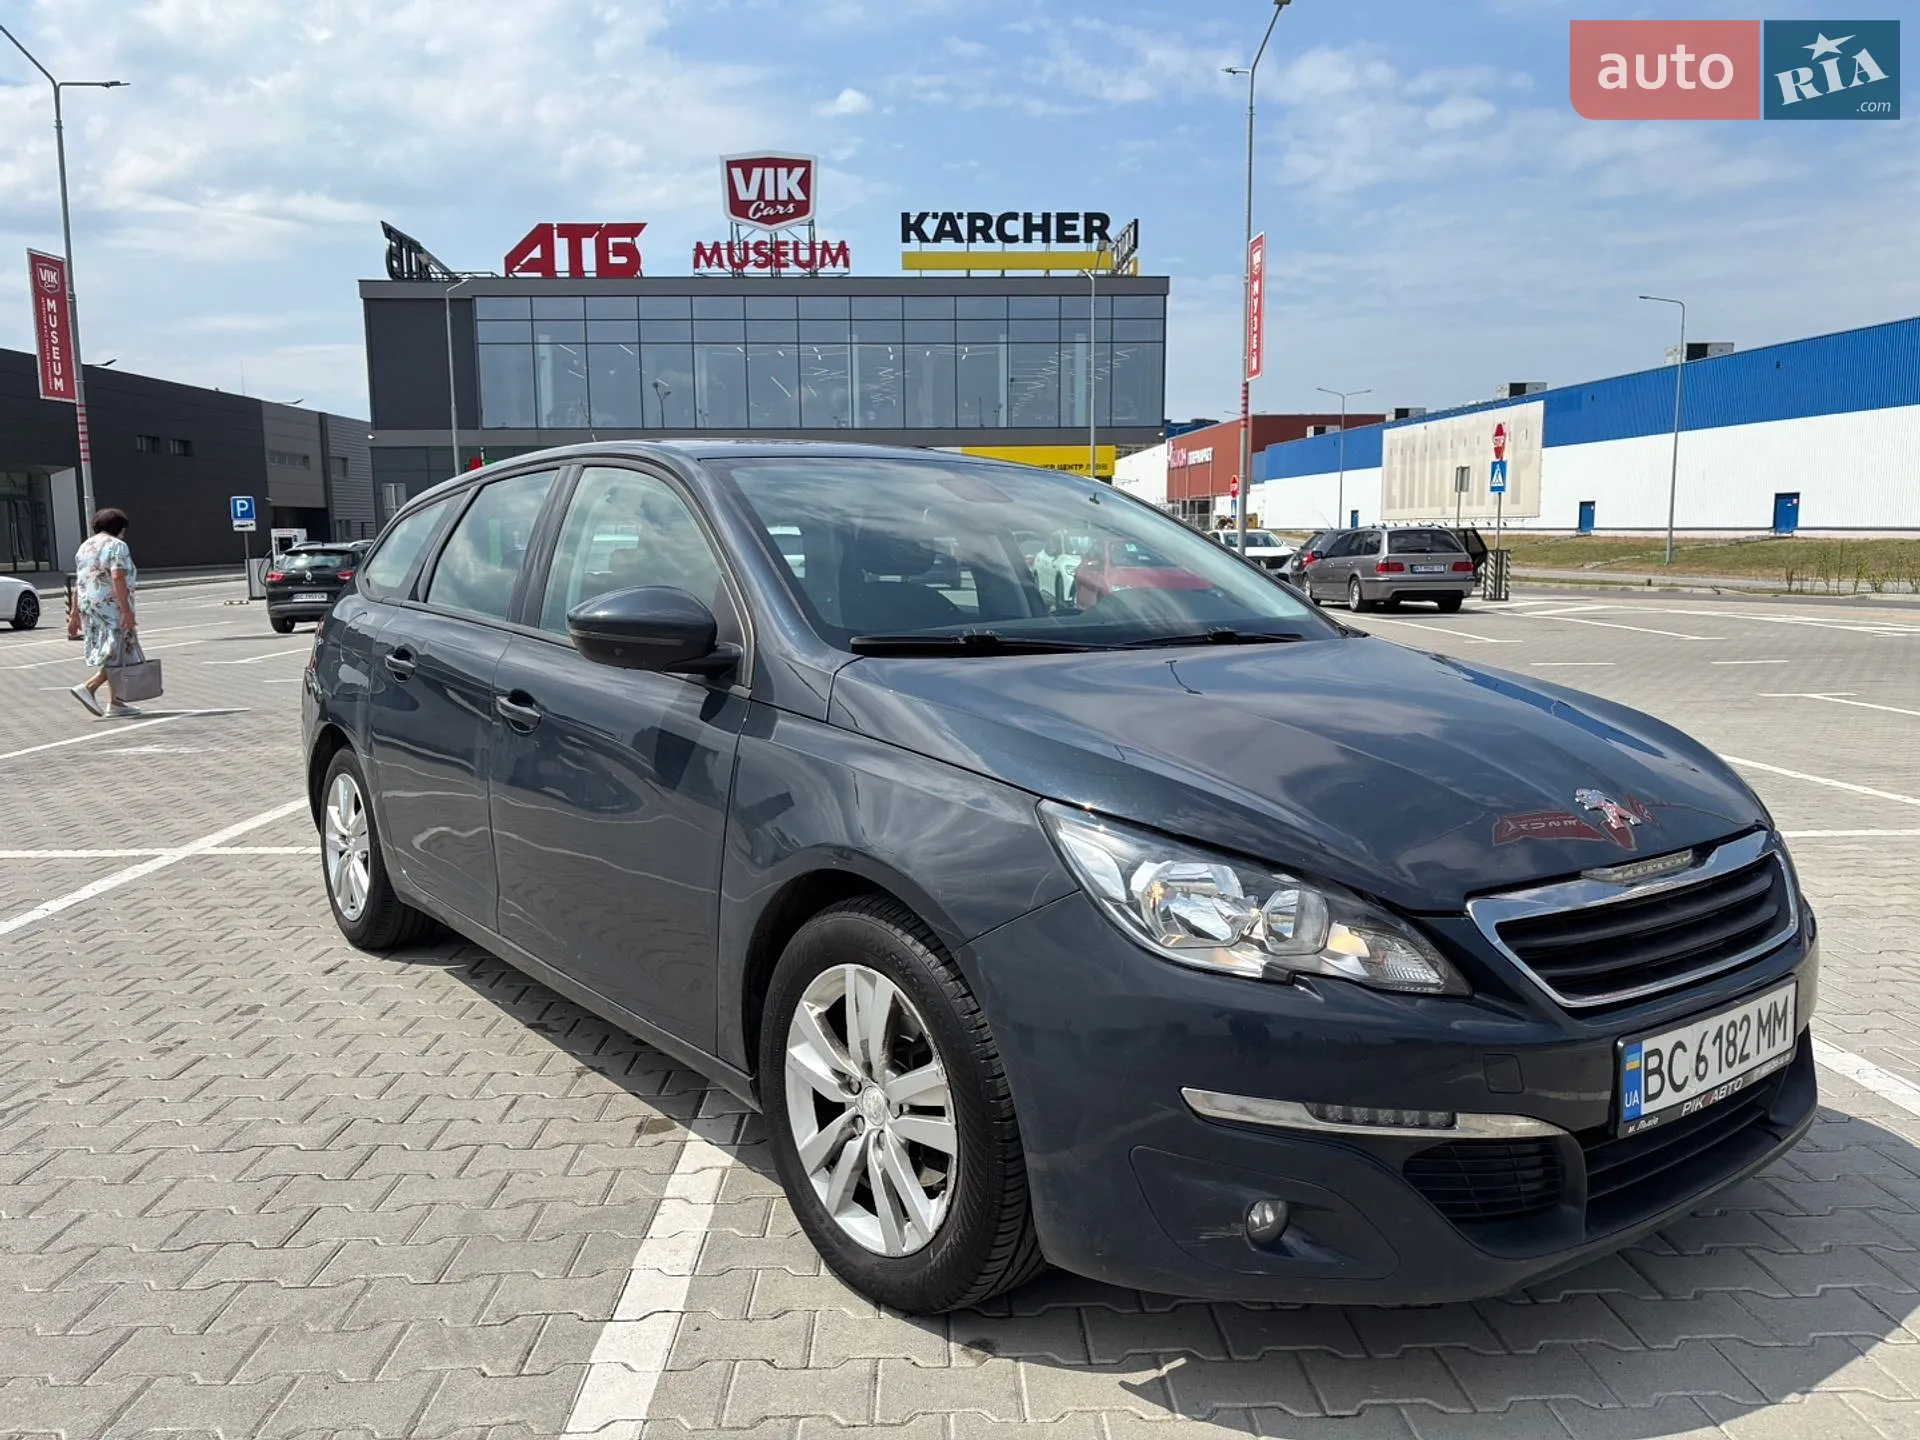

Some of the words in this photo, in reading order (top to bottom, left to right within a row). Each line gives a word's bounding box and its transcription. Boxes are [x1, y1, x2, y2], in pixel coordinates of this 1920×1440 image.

[731, 167, 807, 200] VIK
[748, 201, 797, 220] Cars
[901, 211, 1113, 244] KÄRCHER
[504, 222, 648, 279] АТБ
[693, 240, 850, 270] MUSEUM
[39, 267, 58, 284] VIK
[46, 298, 64, 392] MUSEUM
[236, 500, 248, 517] P
[1643, 1040, 1688, 1104] BC
[1695, 1014, 1751, 1082] 6182
[1757, 995, 1789, 1055] MM
[1624, 1090, 1640, 1108] UA
